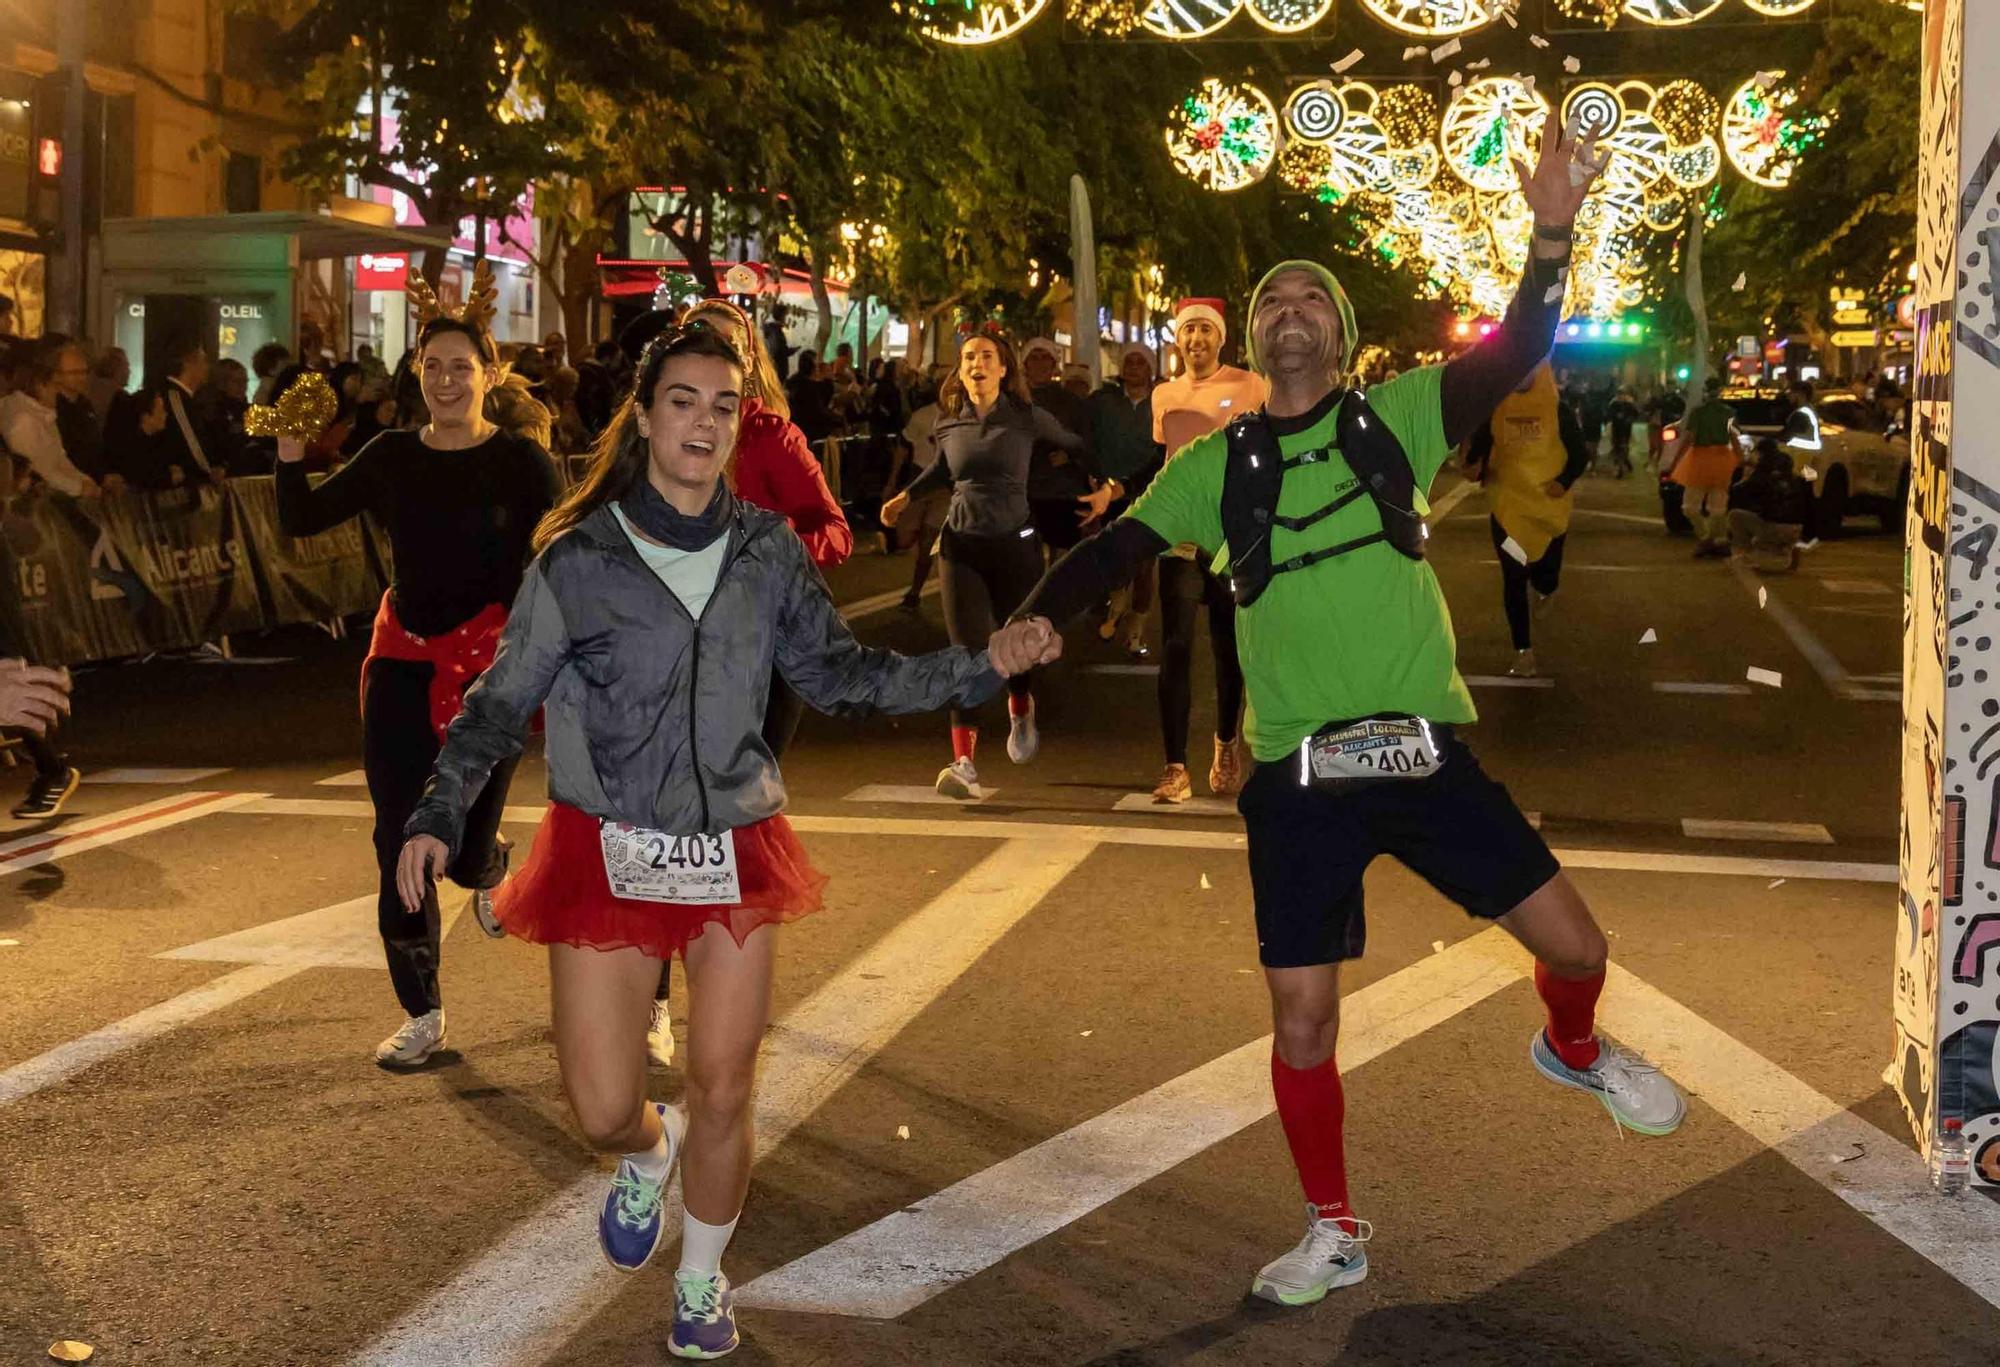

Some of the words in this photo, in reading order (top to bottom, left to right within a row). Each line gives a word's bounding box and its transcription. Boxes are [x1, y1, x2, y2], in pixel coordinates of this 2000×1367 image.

[219, 304, 262, 319] OLEIL
[1344, 736, 1387, 752] ALICANTE
[648, 834, 726, 869] 2403
